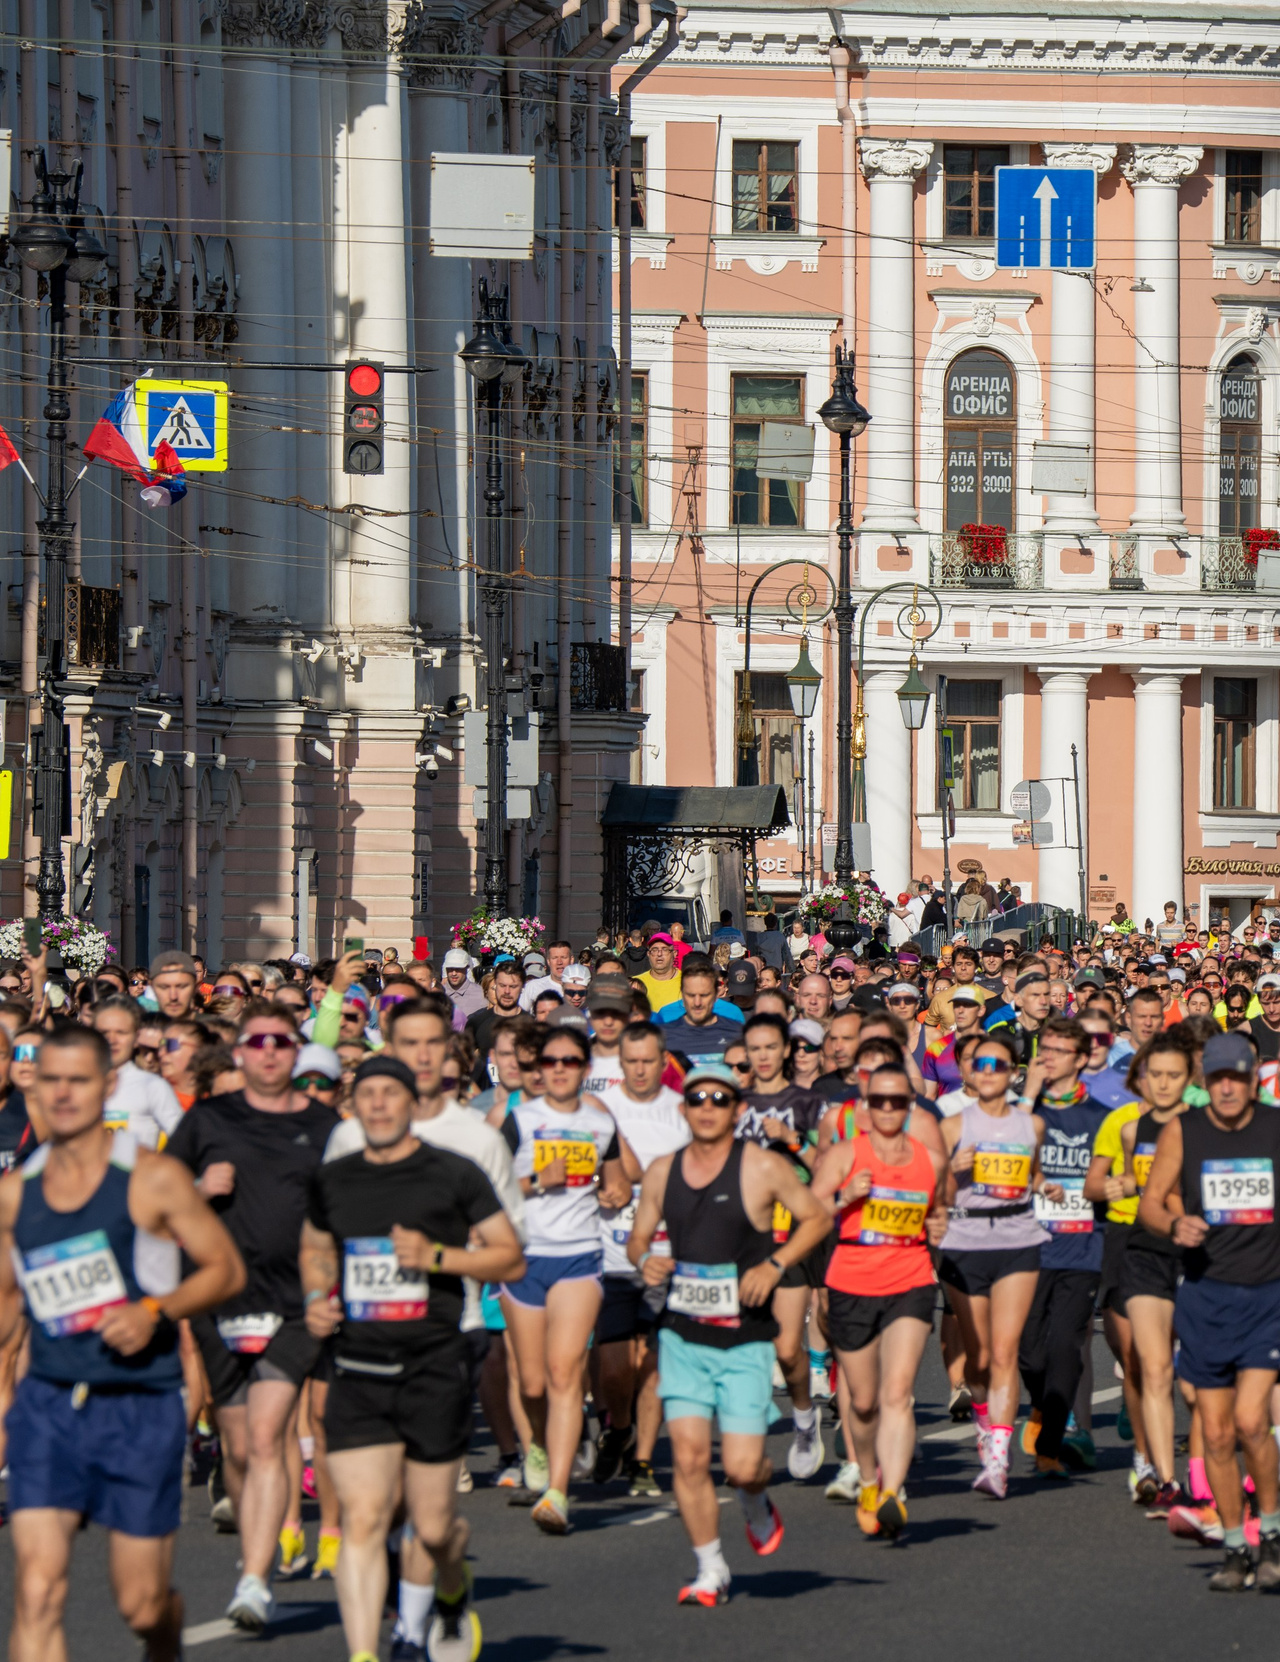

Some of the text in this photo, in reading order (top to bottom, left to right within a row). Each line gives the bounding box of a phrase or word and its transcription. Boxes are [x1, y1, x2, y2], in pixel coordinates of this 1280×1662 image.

[950, 376, 1010, 395] АРЕНДА
[953, 395, 1008, 415] ОФИС
[1221, 398, 1256, 419] ОФИС
[951, 475, 1011, 493] 332 3000
[1240, 479, 1258, 496] 3000
[1185, 857, 1263, 874] Булочная
[538, 1145, 594, 1162] 11254
[981, 1157, 1023, 1176] 9137
[1209, 1178, 1269, 1198] 13958
[869, 1204, 925, 1225] 10973
[31, 1259, 113, 1304] 11108
[675, 1284, 732, 1304] 13081
